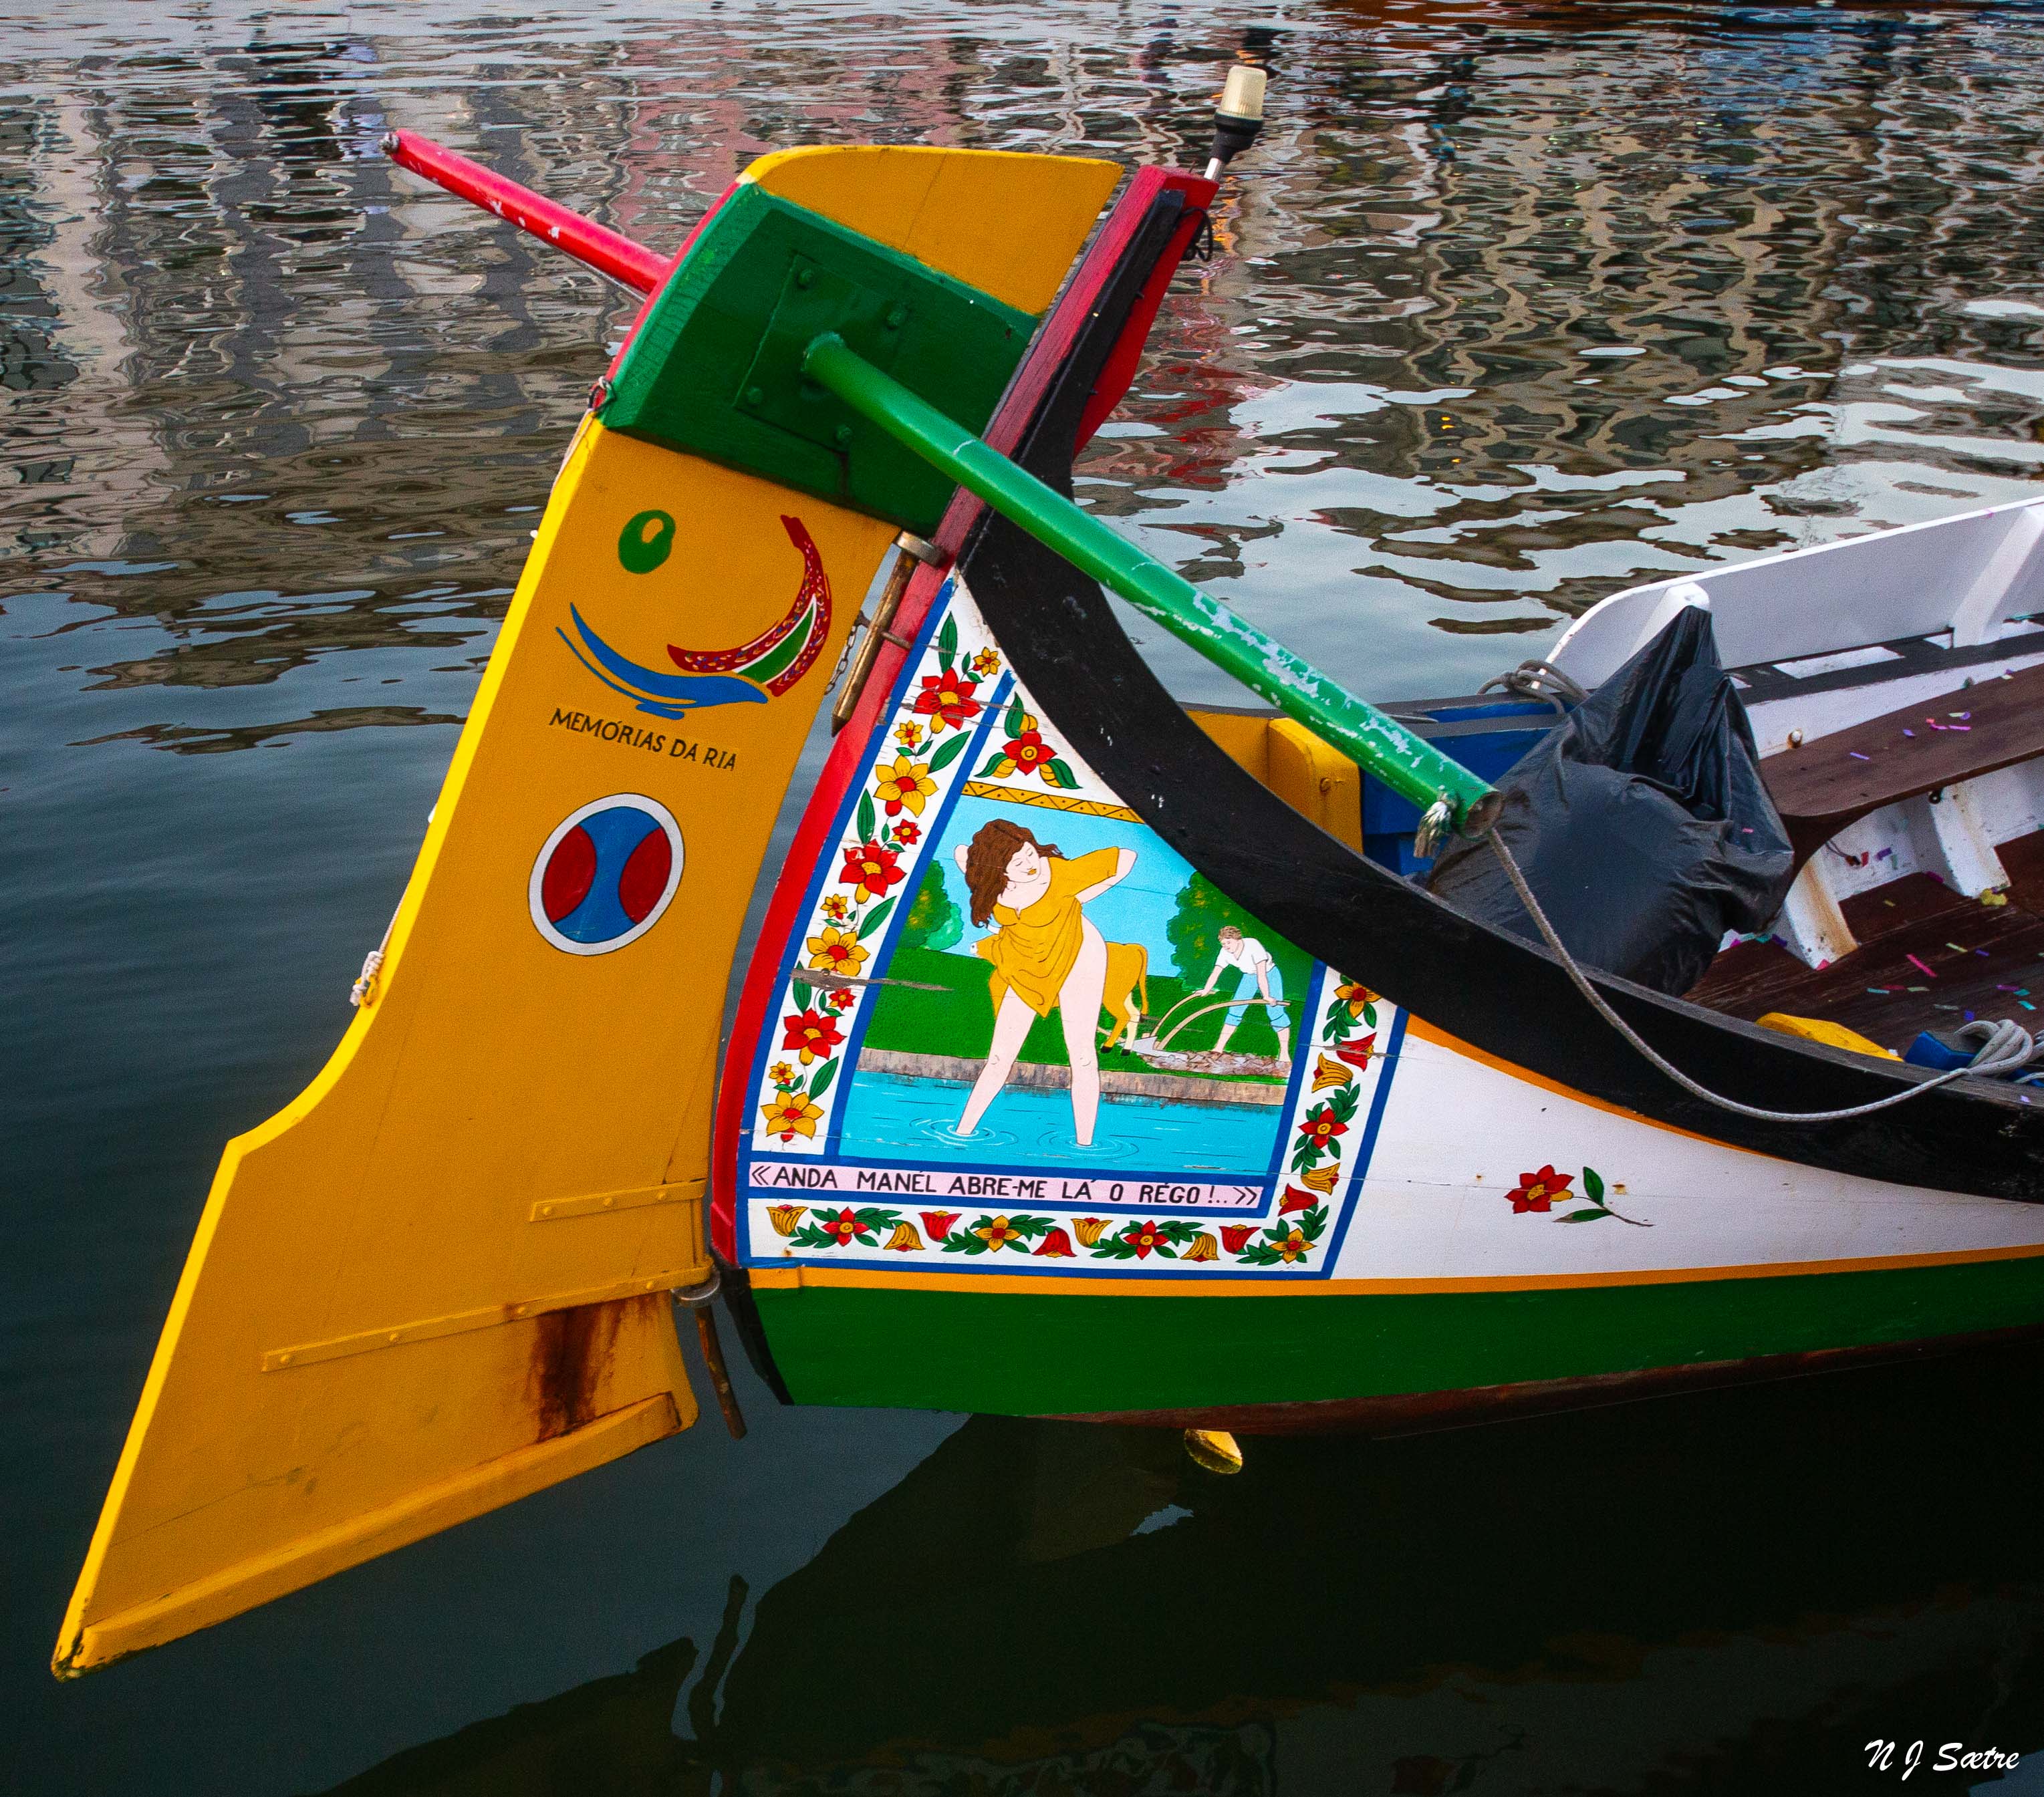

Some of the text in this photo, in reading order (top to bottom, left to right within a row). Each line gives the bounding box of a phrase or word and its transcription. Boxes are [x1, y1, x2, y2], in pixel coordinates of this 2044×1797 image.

[549, 708, 737, 771] MEMÓRIAS DA RIA
[947, 1176, 1048, 1199] ABRE-ME
[1061, 1178, 1097, 1200] LÁ
[1109, 1182, 1124, 1202] O
